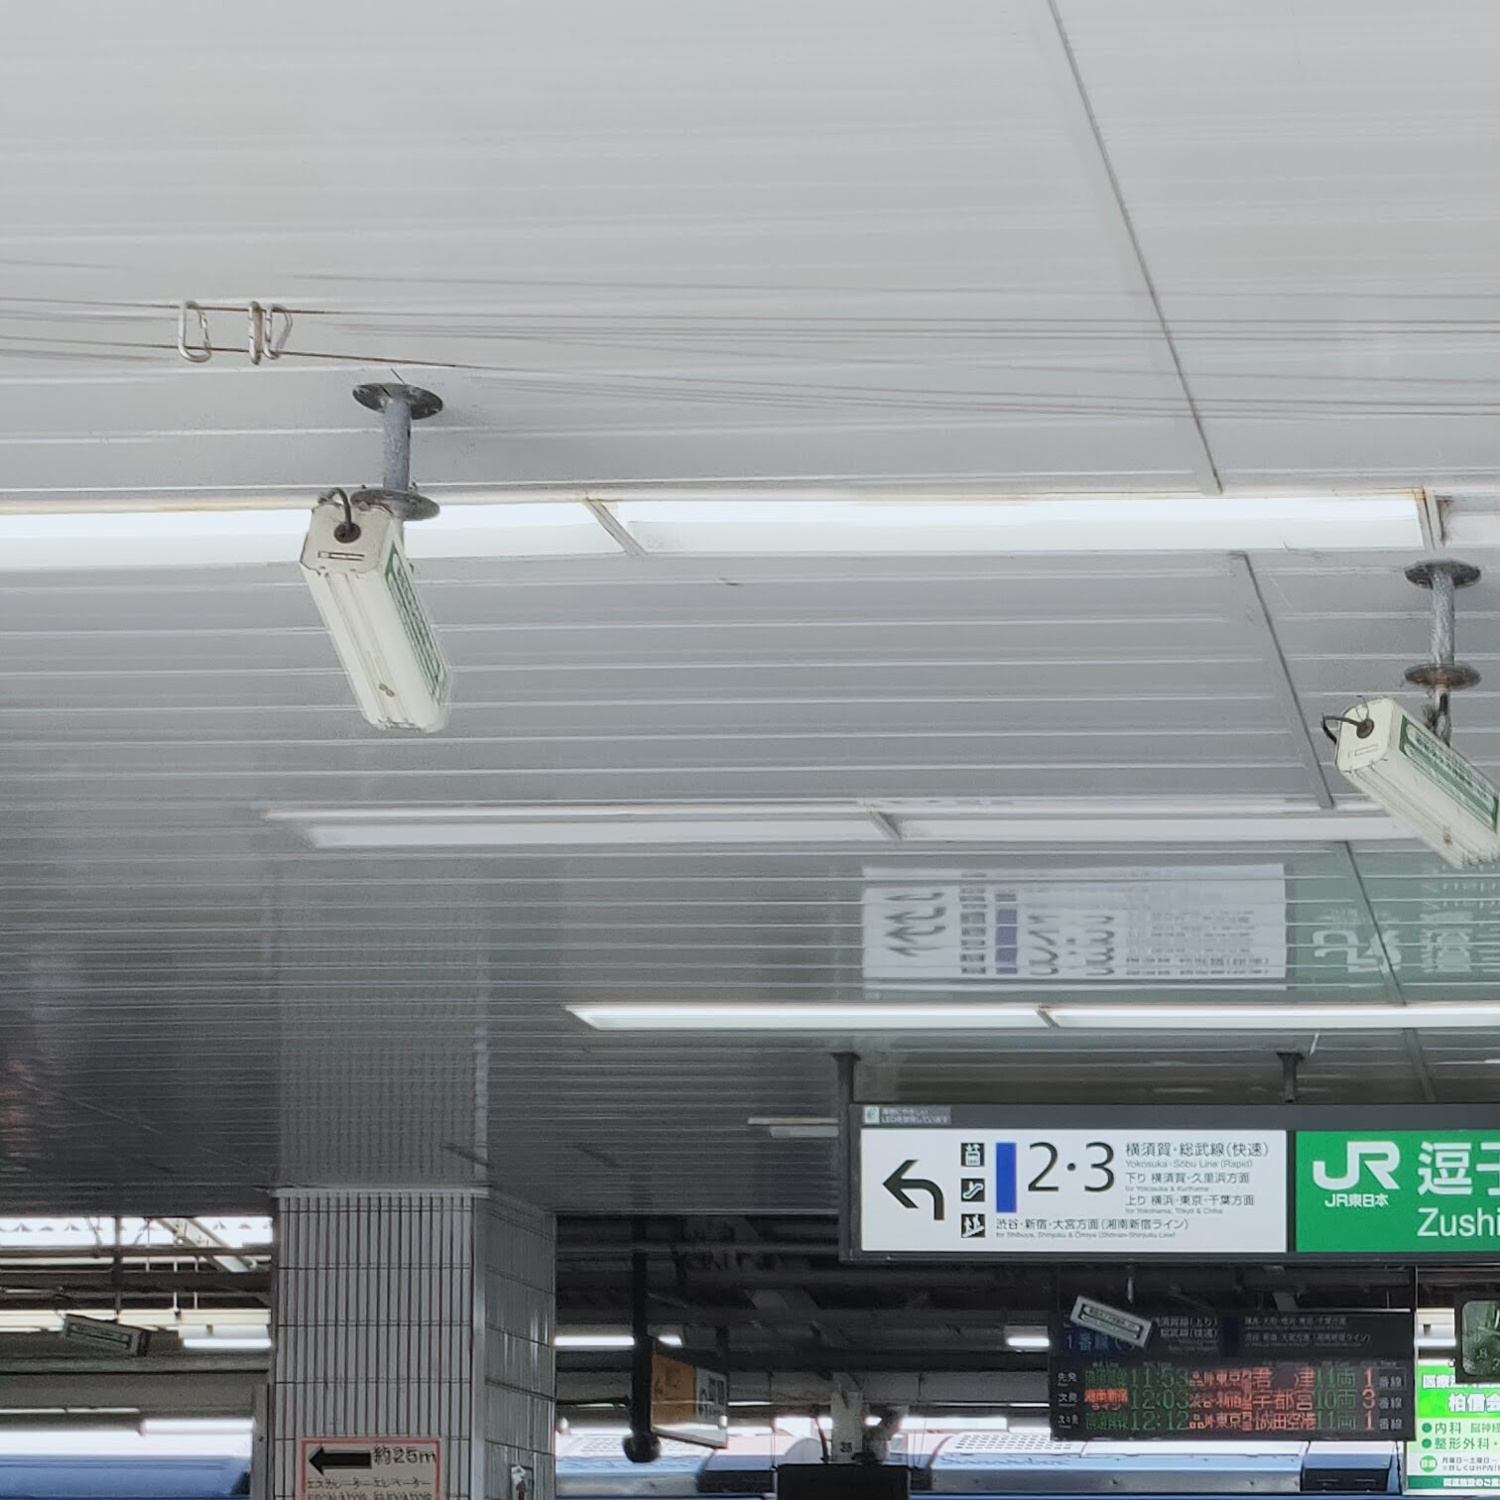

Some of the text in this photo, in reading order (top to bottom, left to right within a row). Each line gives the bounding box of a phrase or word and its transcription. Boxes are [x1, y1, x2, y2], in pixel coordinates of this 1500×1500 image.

[1200, 1160, 1218, 1169] Line
[1313, 1140, 1401, 1190] JR
[1125, 1172, 1146, 1184] 下り
[1125, 1195, 1145, 1206] 上り
[1324, 1193, 1390, 1208] JR東日本
[1131, 1390, 1190, 1410] 12:03
[1362, 1389, 1375, 1409] 3
[1132, 1411, 1190, 1431] 12:12
[1434, 1422, 1462, 1434] 内科
[373, 1446, 436, 1465] 約25m
